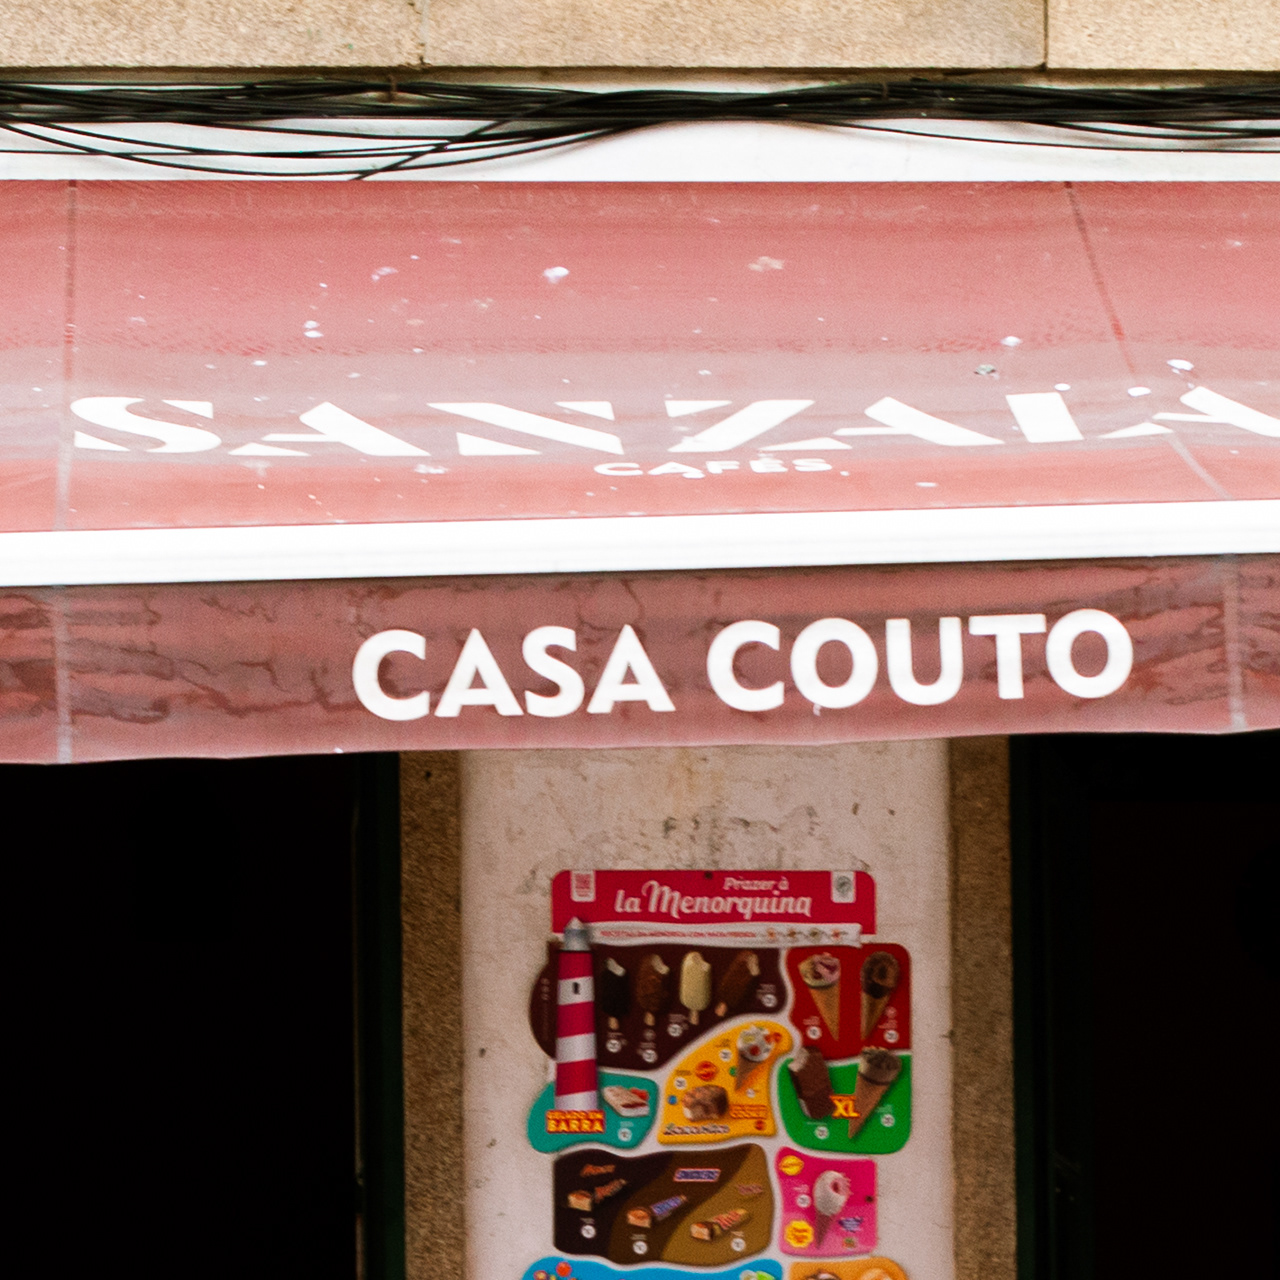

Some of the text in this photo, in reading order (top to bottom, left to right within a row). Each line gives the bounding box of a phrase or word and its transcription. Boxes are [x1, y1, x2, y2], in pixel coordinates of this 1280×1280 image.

[351, 608, 1134, 721] CASA COUTO
[614, 879, 813, 920] la Menorquina
[831, 1098, 861, 1120] XL
